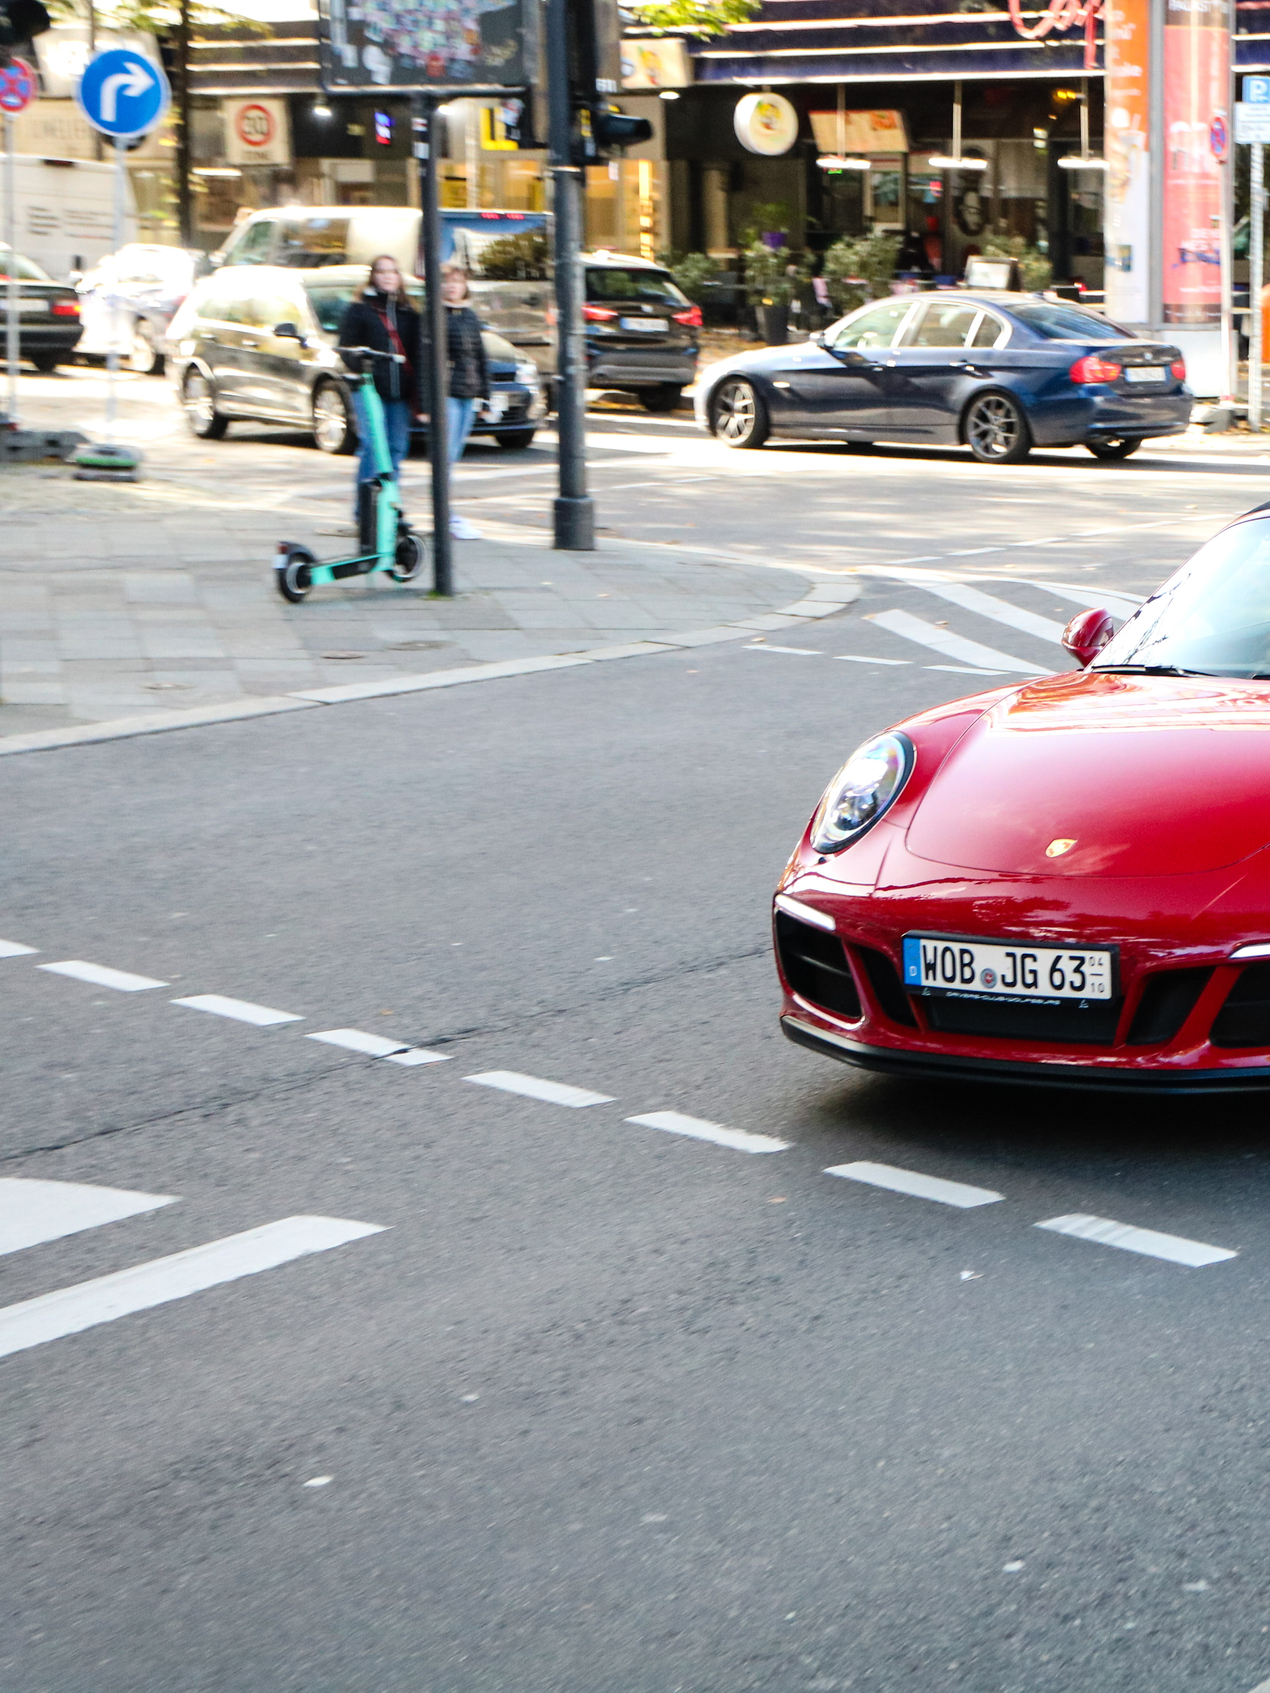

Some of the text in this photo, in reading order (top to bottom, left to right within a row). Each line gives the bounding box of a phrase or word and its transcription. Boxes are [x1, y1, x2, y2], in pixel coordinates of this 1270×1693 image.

[922, 945, 1086, 992] WOB JG 63
